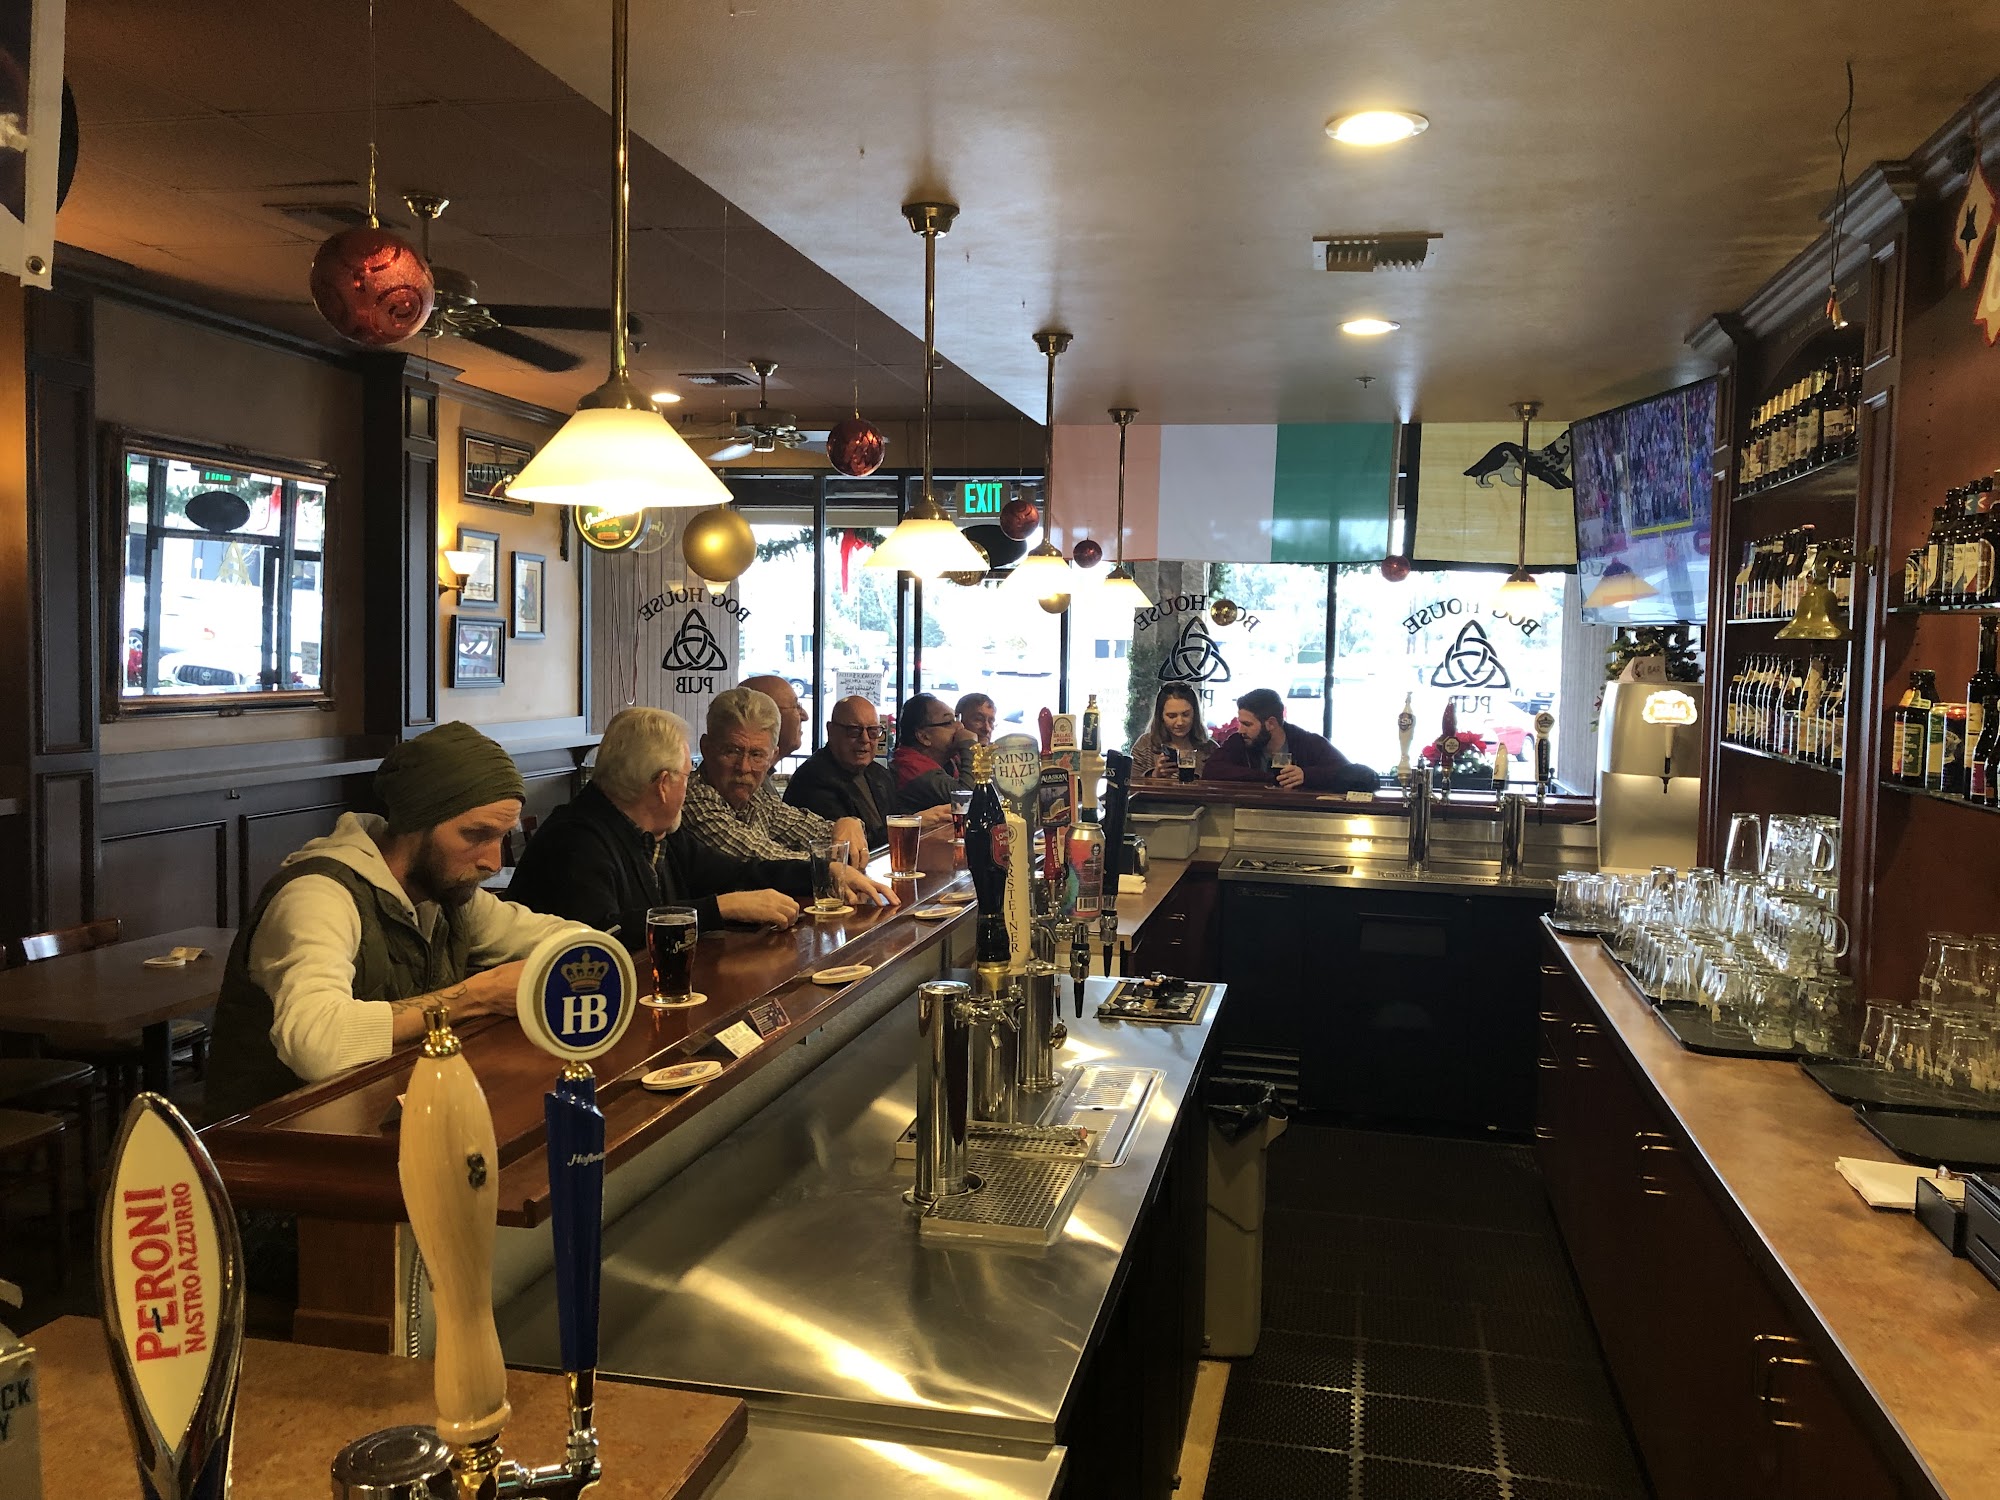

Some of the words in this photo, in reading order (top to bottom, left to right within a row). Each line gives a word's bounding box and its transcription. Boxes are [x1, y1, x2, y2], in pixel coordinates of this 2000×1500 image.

[965, 483, 1002, 513] EXIT
[999, 753, 1034, 764] MIND
[1000, 764, 1036, 778] HAZE
[1012, 779, 1025, 787] IPA
[1041, 773, 1068, 783] ALASKAN
[1052, 836, 1060, 868] AMBER
[561, 993, 608, 1035] HB
[171, 1181, 199, 1271] AZZURRO
[124, 1185, 182, 1362] PERONI
[182, 1274, 208, 1355] NASTRO
